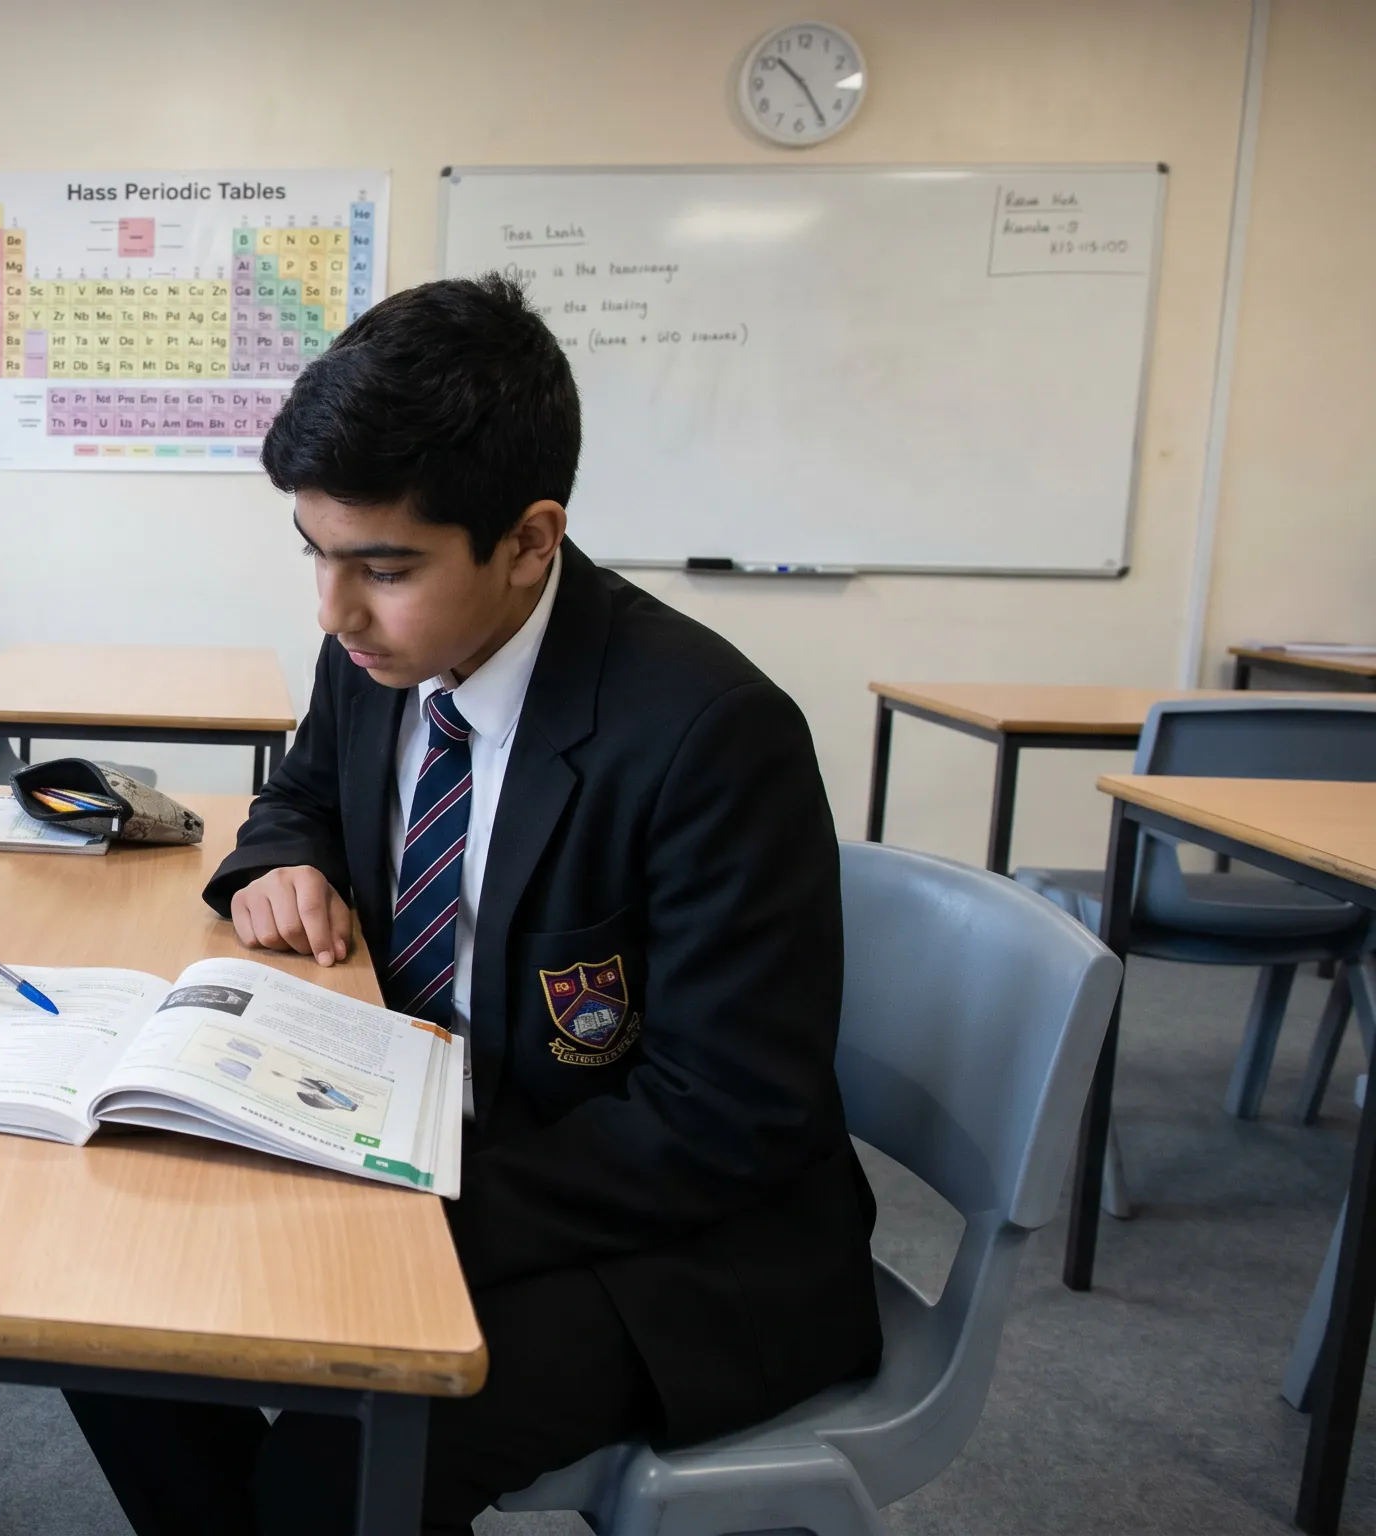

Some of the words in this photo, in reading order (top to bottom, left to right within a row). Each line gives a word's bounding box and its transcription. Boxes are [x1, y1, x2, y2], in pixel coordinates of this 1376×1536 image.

[777, 39, 790, 53] 11
[798, 33, 813, 49] 12
[761, 56, 777, 71] 10
[753, 78, 763, 90] 9
[67, 183, 117, 201] Hass
[124, 182, 212, 201] Periodic
[218, 182, 286, 200] Tables
